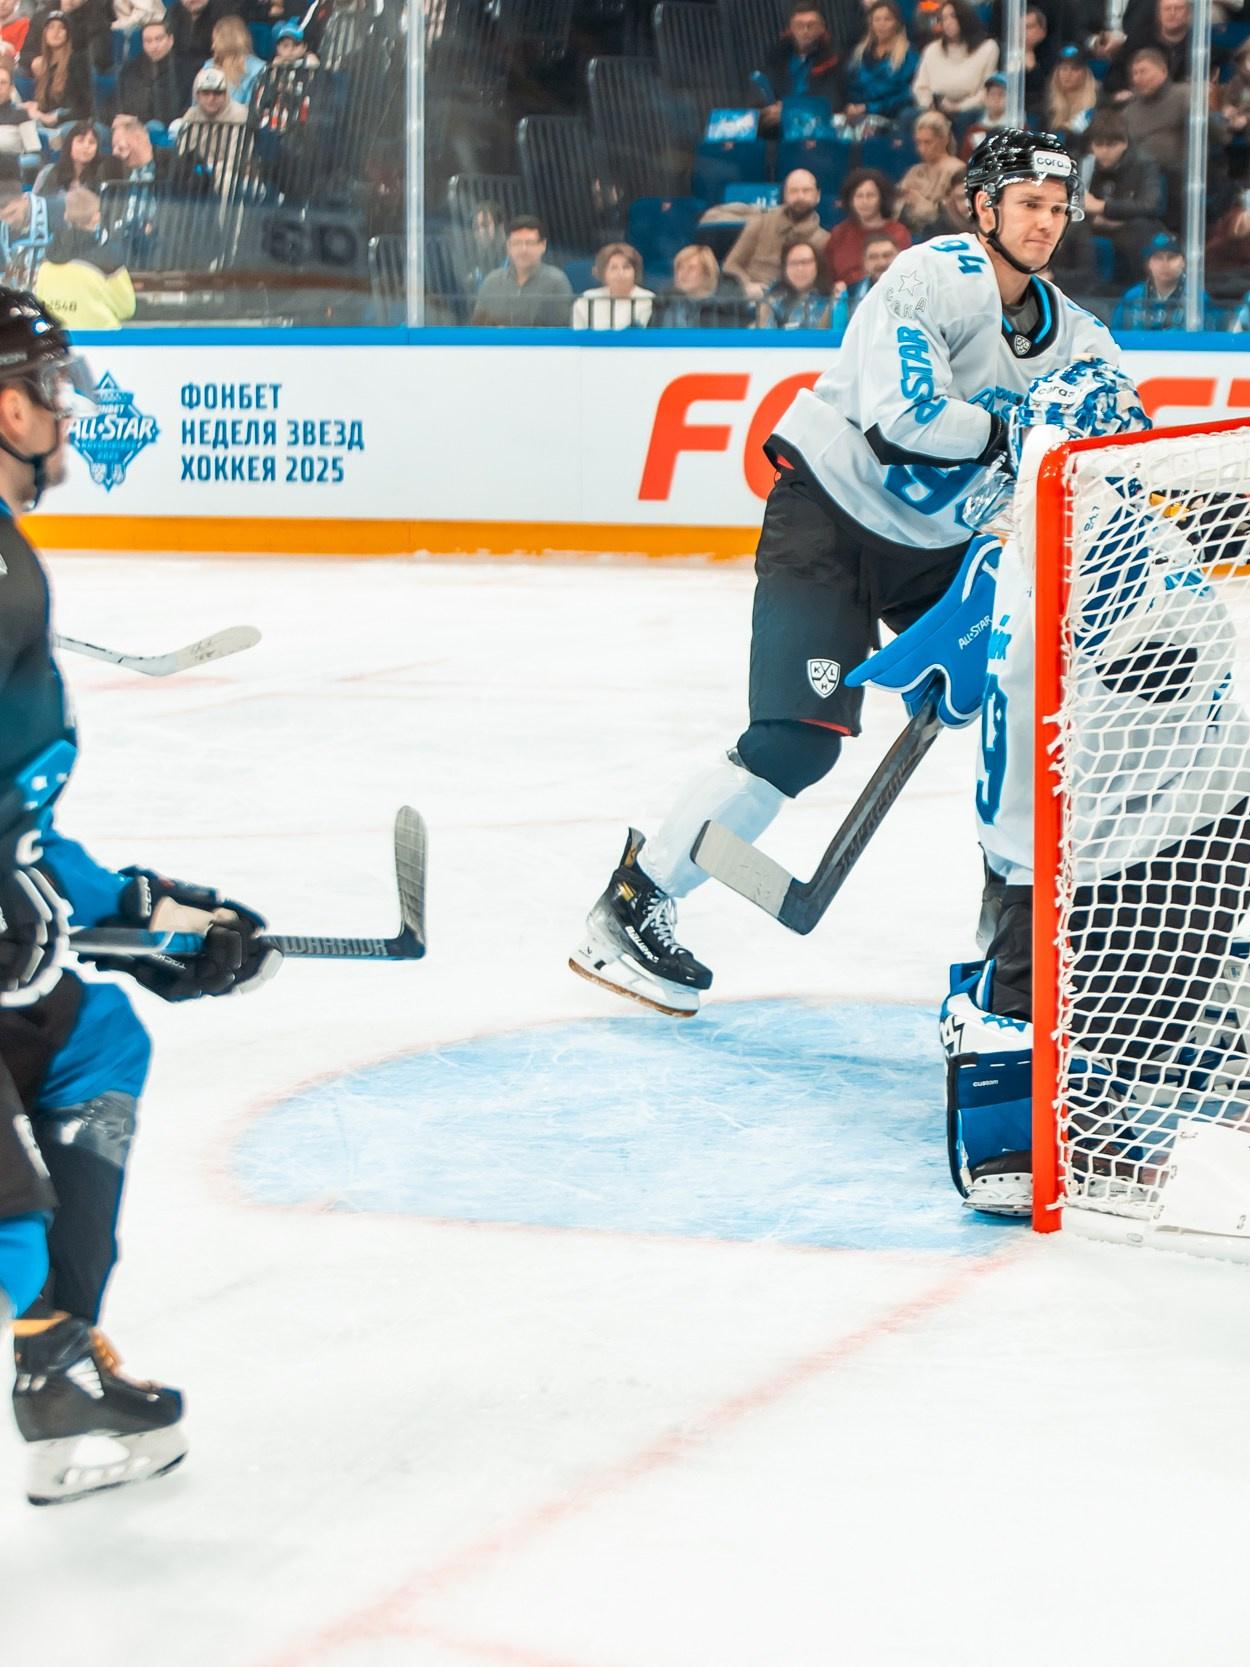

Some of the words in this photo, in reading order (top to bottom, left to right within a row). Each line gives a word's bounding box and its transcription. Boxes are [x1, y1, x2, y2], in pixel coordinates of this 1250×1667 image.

[930, 239, 988, 275] 94
[180, 382, 283, 410] ФОНБЕТ
[181, 419, 277, 450] НЕДЕЛЯ
[286, 419, 365, 451] ЗВЕЗД
[180, 455, 276, 481] ХОККЕЯ
[285, 456, 345, 482] 2025
[282, 936, 389, 957] WARRIOR
